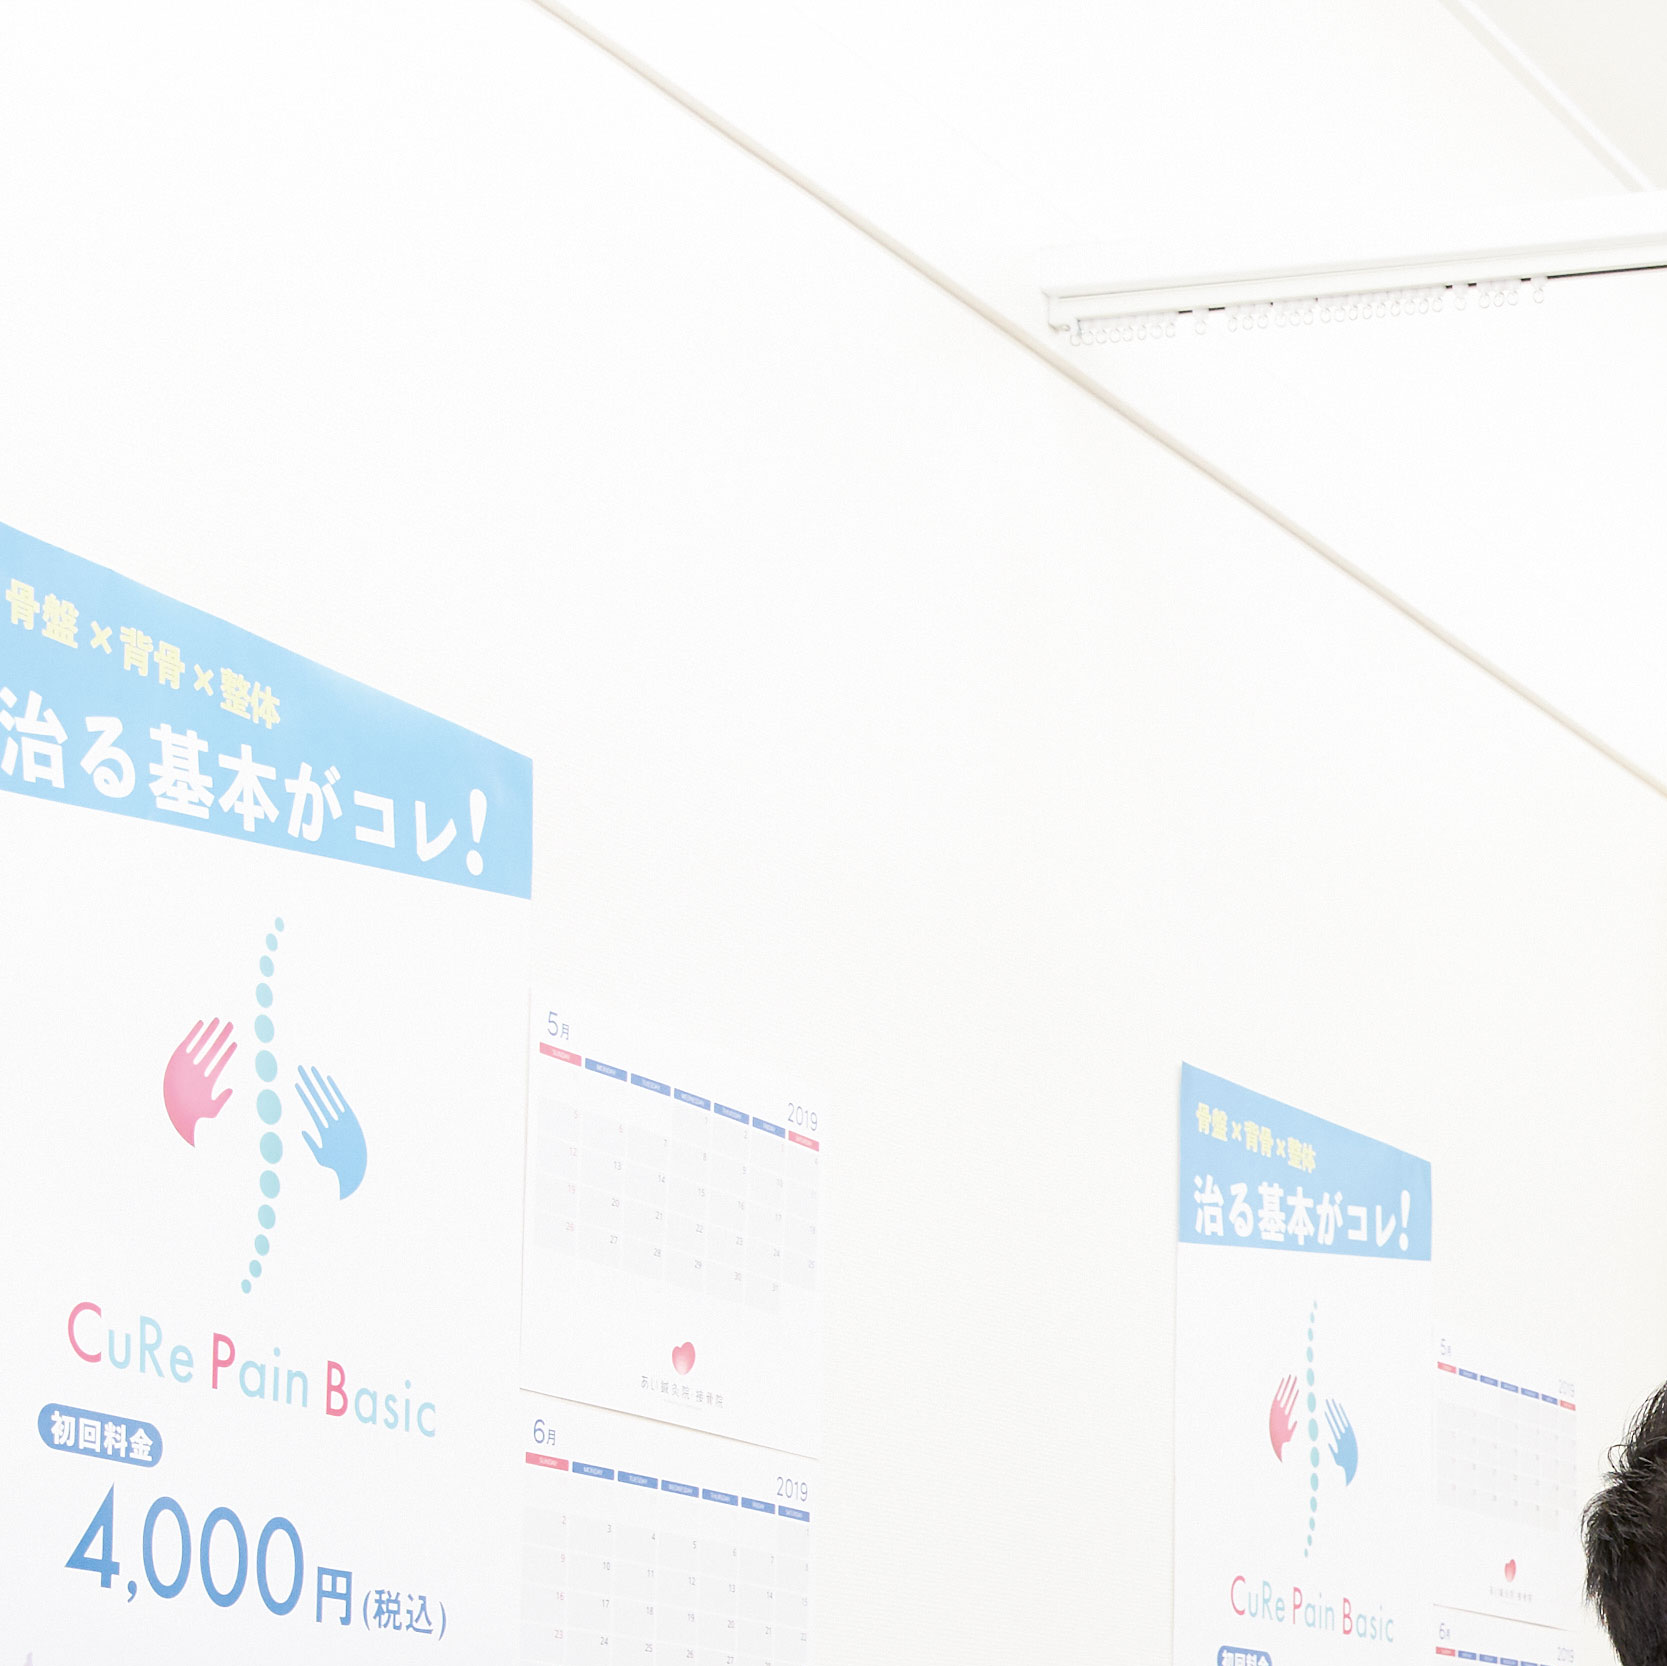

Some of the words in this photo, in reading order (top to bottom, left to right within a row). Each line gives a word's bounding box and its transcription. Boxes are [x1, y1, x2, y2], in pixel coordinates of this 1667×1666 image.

[0, 686, 488, 876] 治る基本がコレ!
[547, 1011, 571, 1041] 5月
[787, 1103, 819, 1132] 2019
[67, 1301, 194, 1384] CuRe
[211, 1331, 309, 1408] Pain
[325, 1359, 437, 1438] Basic
[50, 1409, 154, 1462] 初回料金
[533, 1418, 557, 1447] 6月
[776, 1476, 809, 1503] 2019
[1230, 1575, 1286, 1623] CuRe
[1292, 1586, 1336, 1631] Pain
[1341, 1596, 1395, 1643] Basic
